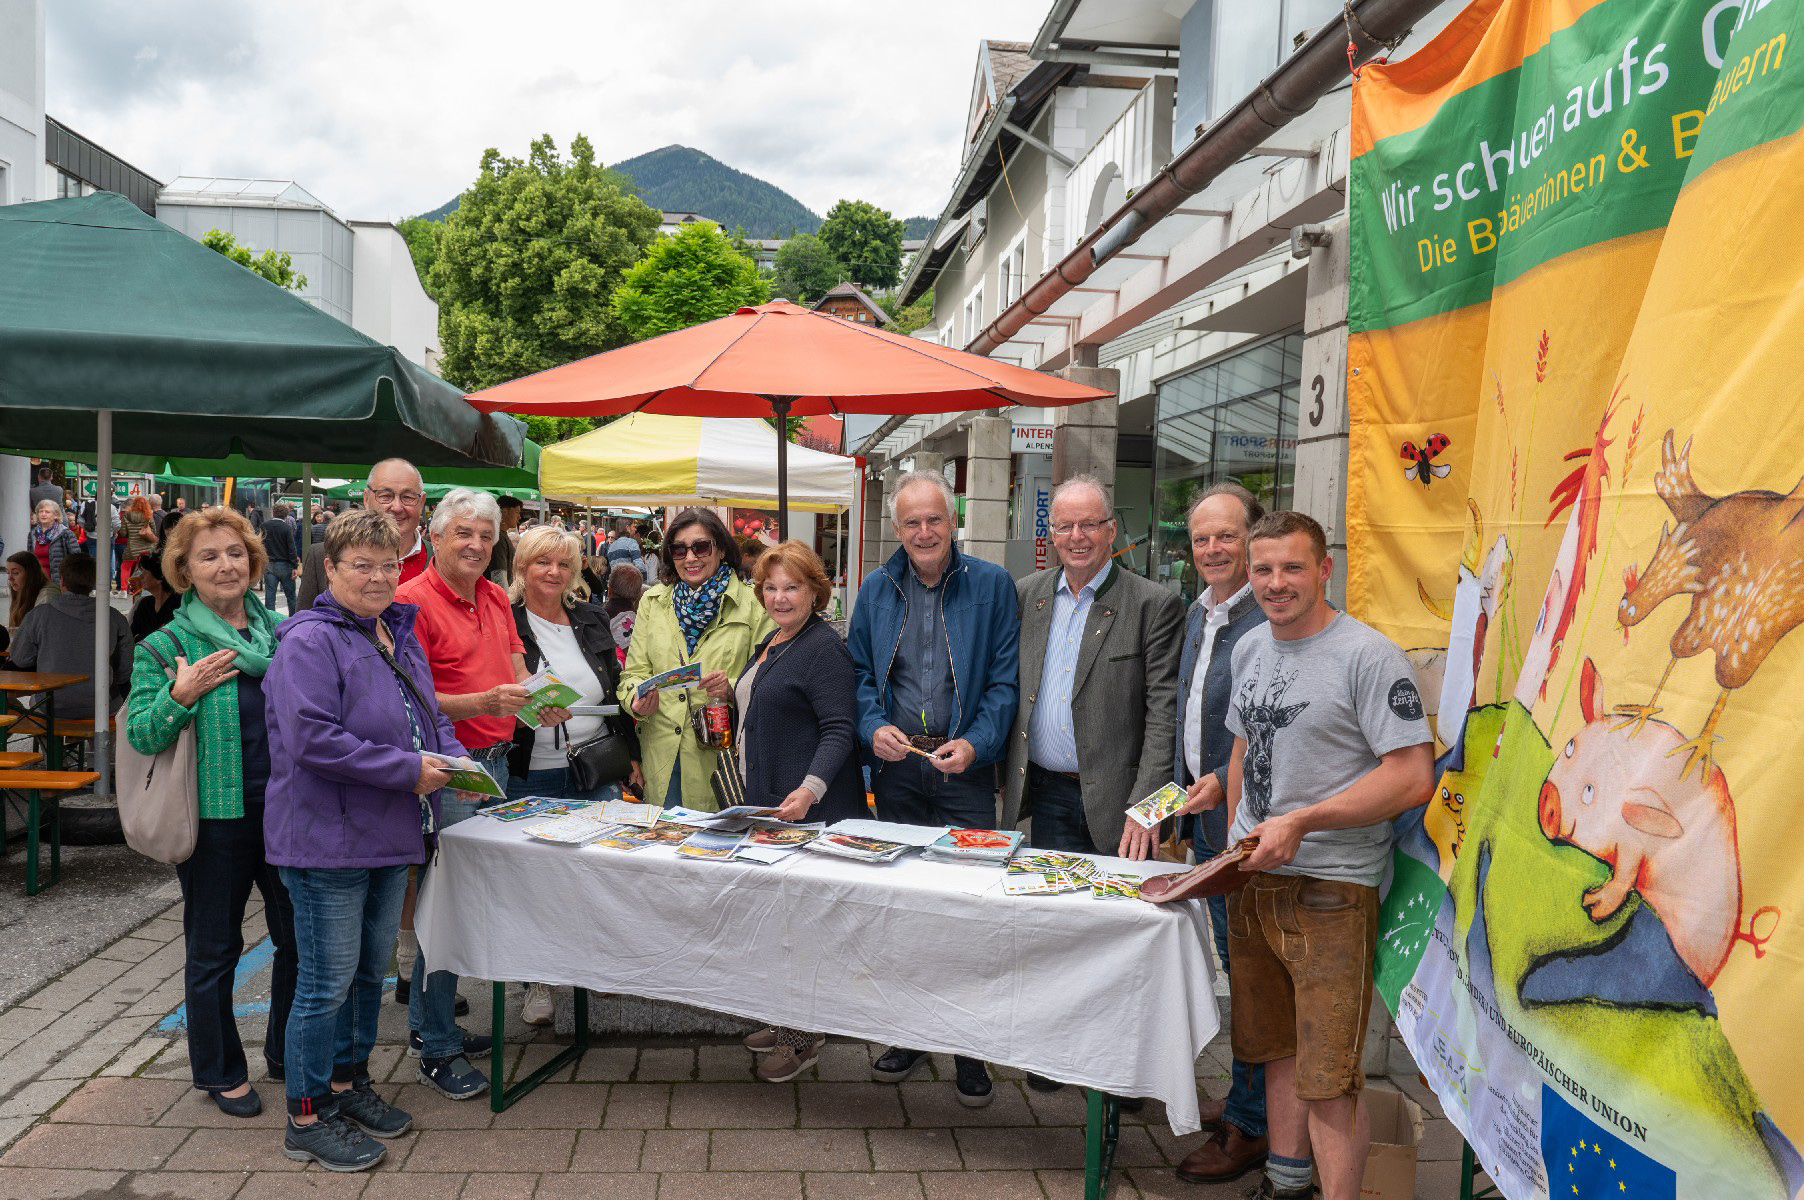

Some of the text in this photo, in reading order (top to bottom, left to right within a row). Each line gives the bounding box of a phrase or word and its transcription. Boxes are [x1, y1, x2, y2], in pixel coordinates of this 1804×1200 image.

[1382, 36, 1669, 235] Wir schuen aufs
[1418, 234, 1457, 273] Die
[1617, 128, 1650, 173] &
[1016, 428, 1053, 439] INTER
[1309, 375, 1325, 427] 3
[1036, 489, 1049, 571] NTERSPORT
[1490, 1006, 1506, 1031] UND
[1507, 1024, 1588, 1105] EUROPÄISCHER
[1592, 1094, 1648, 1142] UNION
